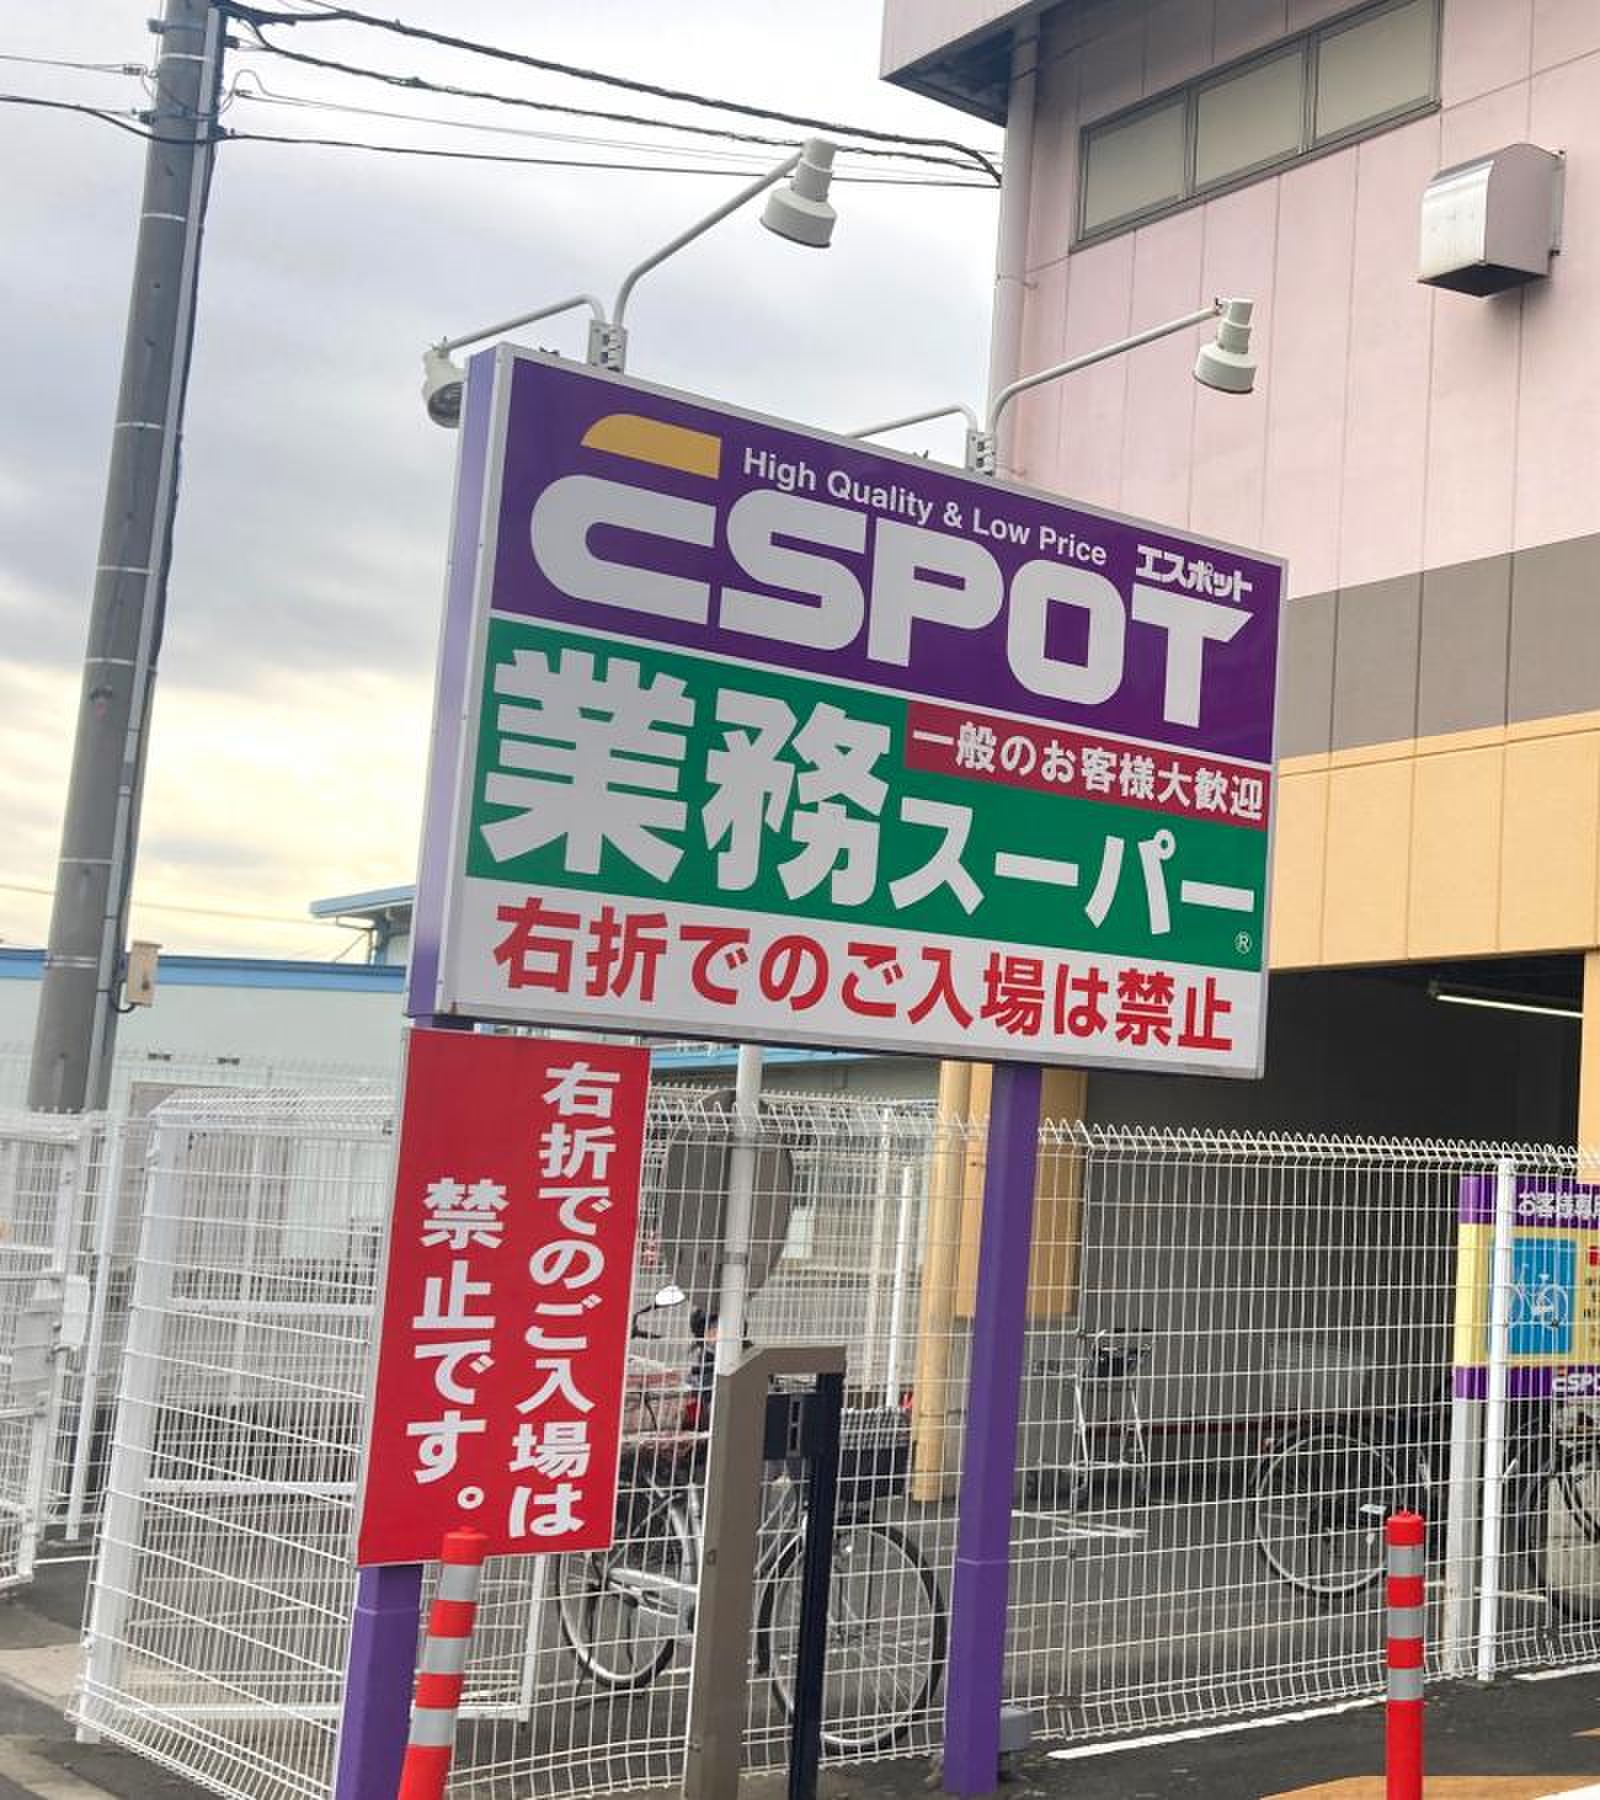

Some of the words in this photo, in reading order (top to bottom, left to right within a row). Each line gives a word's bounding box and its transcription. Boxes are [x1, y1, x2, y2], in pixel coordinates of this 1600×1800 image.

[531, 413, 1254, 728] ESPOT
[743, 446, 817, 494] High
[828, 469, 934, 527] Quality
[943, 501, 964, 529] &
[973, 508, 1030, 545] Low
[1040, 525, 1108, 567] Price
[1137, 543, 1253, 602] エスポット
[480, 647, 1255, 935] 業務スーパー
[912, 721, 1263, 821] 一般のお客様大歓迎
[492, 897, 1232, 1051] 右折でのご入場は禁止
[406, 1177, 507, 1510] 禁止です。
[508, 1061, 621, 1538] 右折でのご入場は
